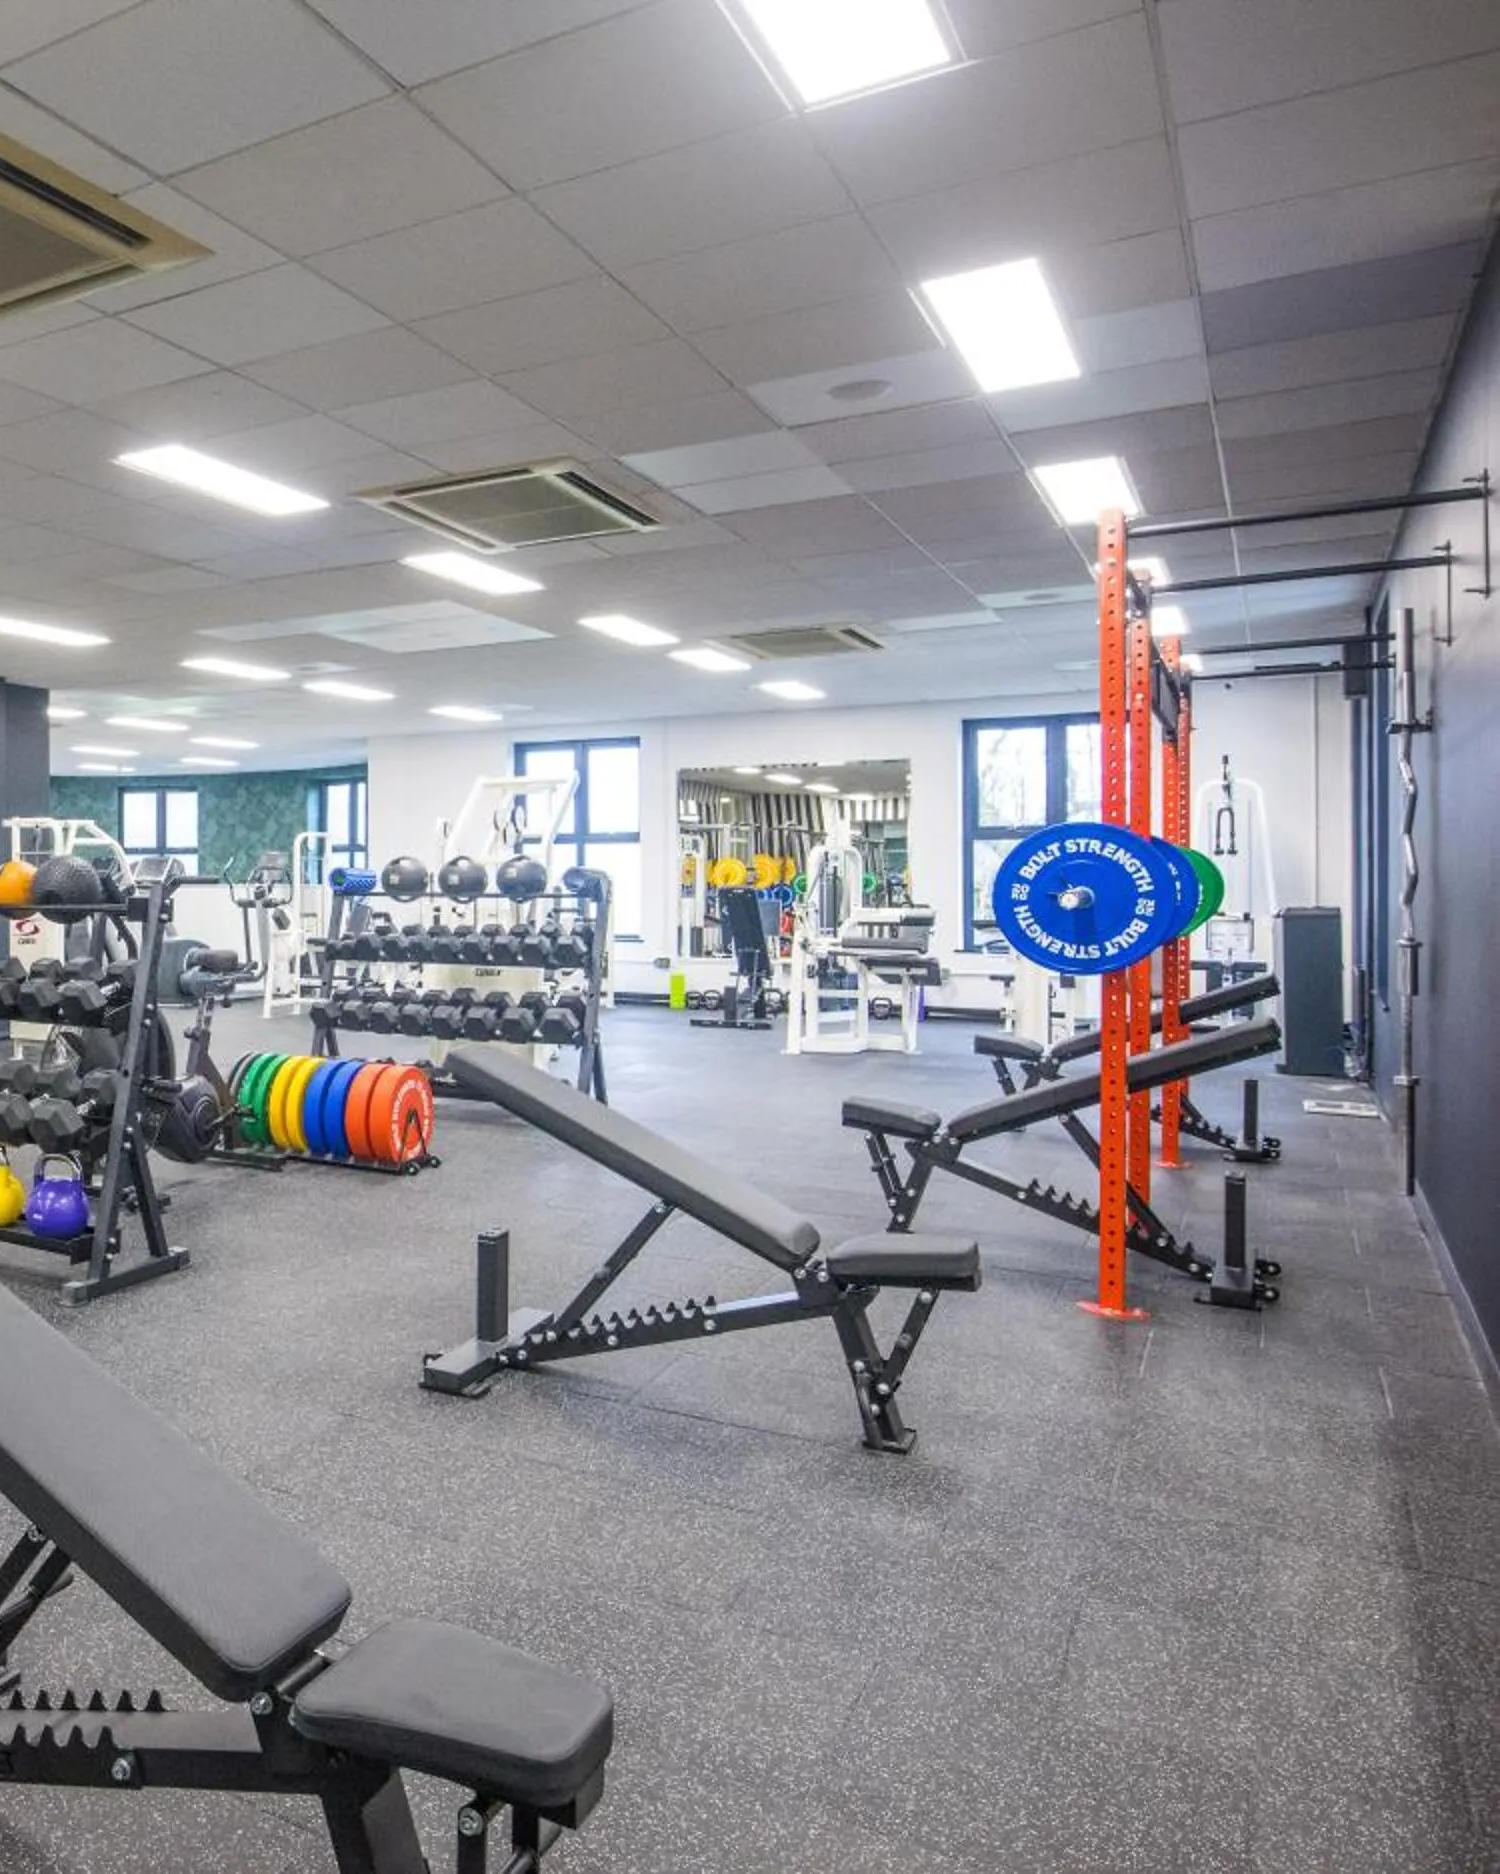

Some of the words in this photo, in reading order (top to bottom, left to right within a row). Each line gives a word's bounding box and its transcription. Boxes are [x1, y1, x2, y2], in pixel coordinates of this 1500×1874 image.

[1019, 843, 1061, 880] BOLT
[1064, 838, 1155, 893] STRENGTH
[1013, 905, 1101, 959] STRENGTH
[1104, 918, 1149, 957] BOLT
